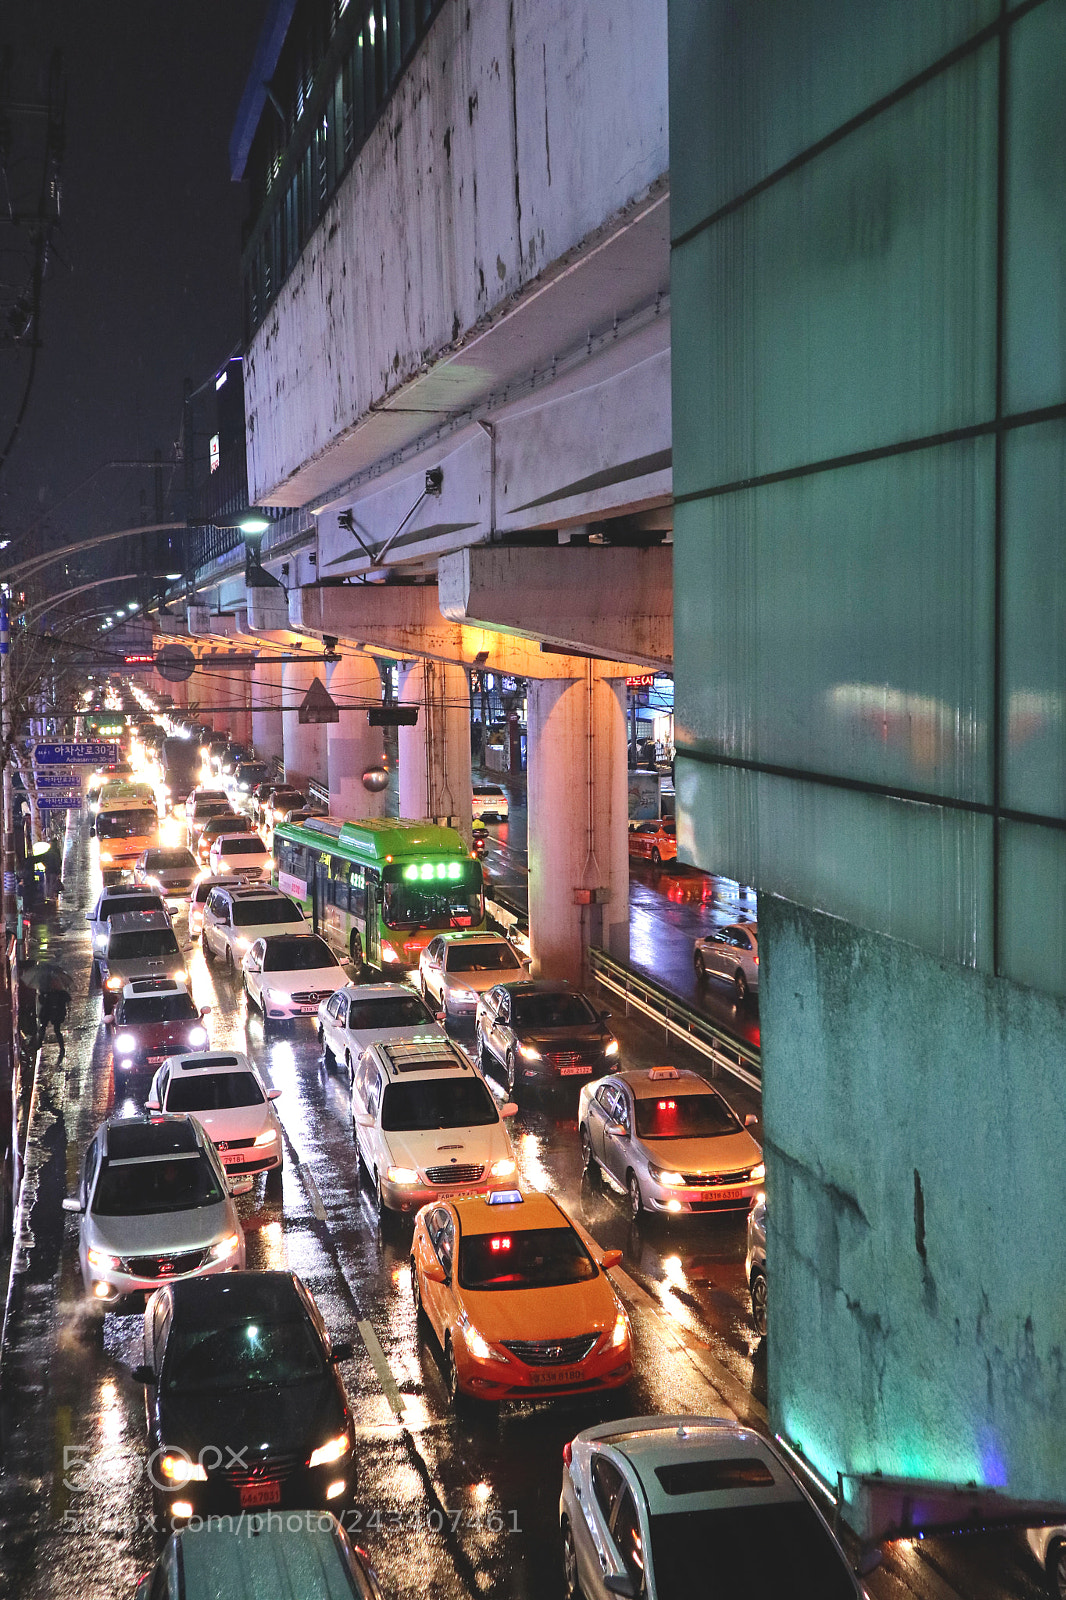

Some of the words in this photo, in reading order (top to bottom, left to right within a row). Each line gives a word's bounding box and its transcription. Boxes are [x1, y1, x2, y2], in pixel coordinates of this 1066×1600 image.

[54, 745, 116, 757] 아차산로30길
[405, 862, 461, 880] 4212
[350, 872, 365, 889] 4212
